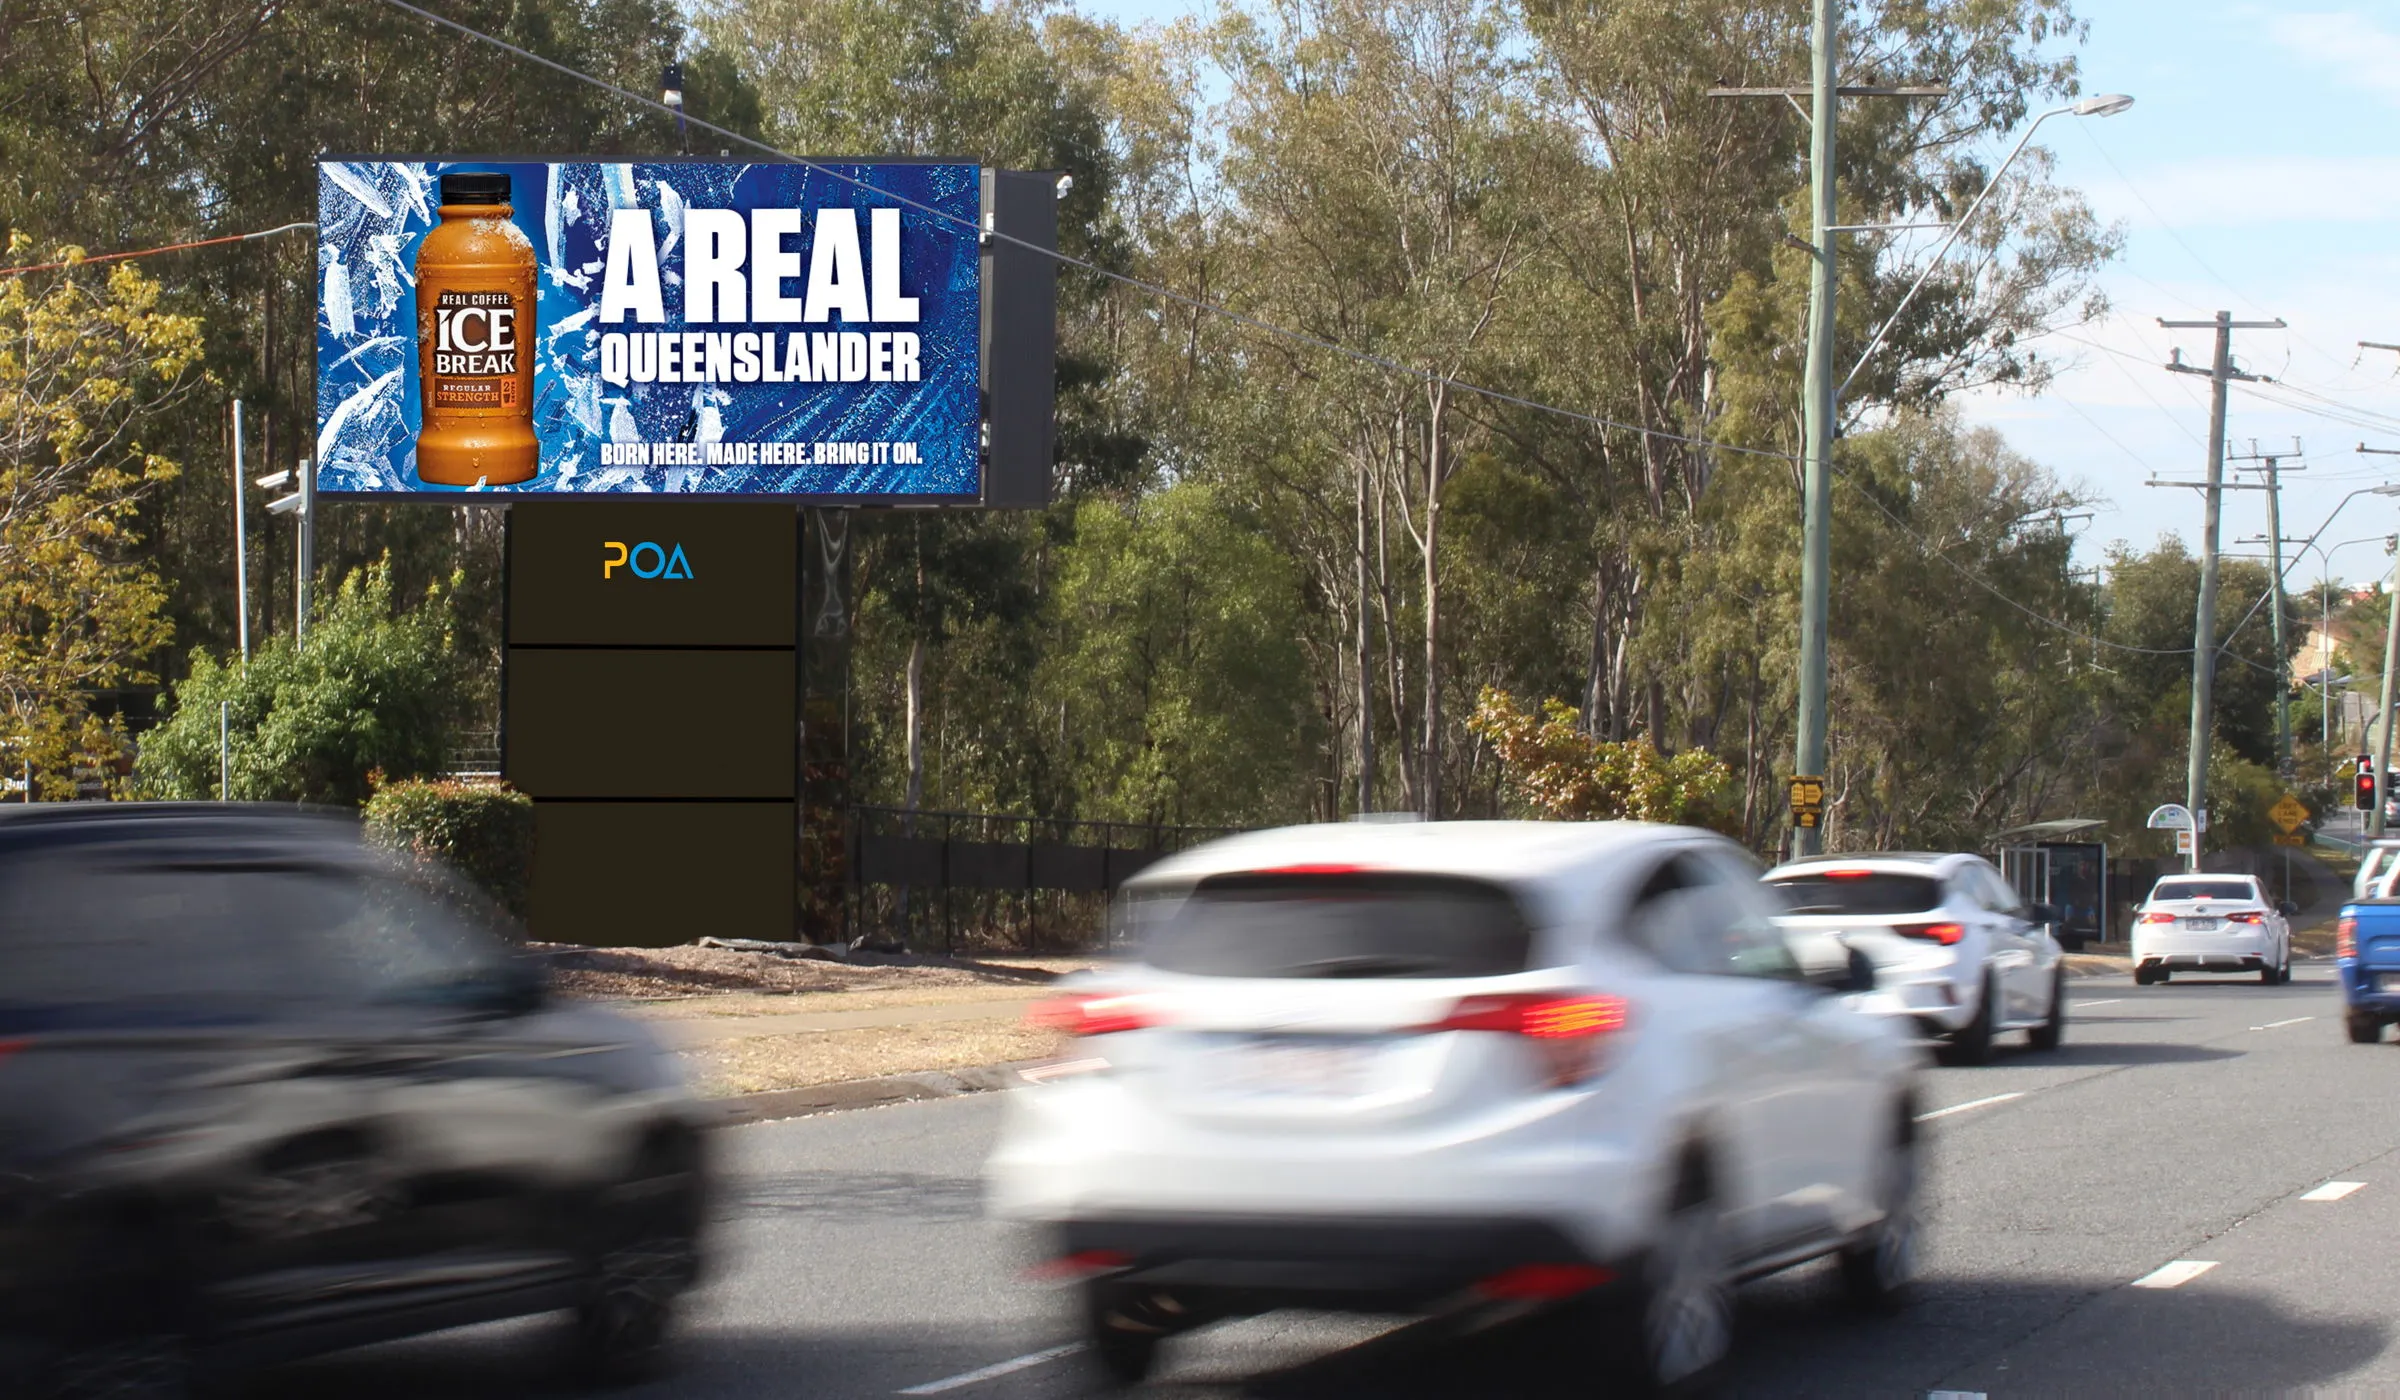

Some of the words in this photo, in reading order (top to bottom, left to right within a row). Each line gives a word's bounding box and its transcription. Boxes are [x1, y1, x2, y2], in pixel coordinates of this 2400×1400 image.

[599, 208, 666, 323] A
[684, 207, 920, 323] REAL
[442, 294, 468, 306] REAL
[471, 294, 509, 305] COFFEE
[436, 307, 515, 353] ICE
[436, 353, 515, 374] BREAK
[600, 331, 921, 389] QUEENSLANDER
[436, 391, 499, 402] STRENGTH
[443, 384, 491, 392] REGULAR
[600, 442, 649, 465] BORN
[653, 442, 703, 465] HERE.
[707, 442, 757, 465] MADE
[761, 442, 811, 465] HERE.
[815, 442, 873, 465] BRING
[873, 442, 890, 465] IT
[893, 442, 923, 465] ON.
[604, 541, 695, 579] POA
